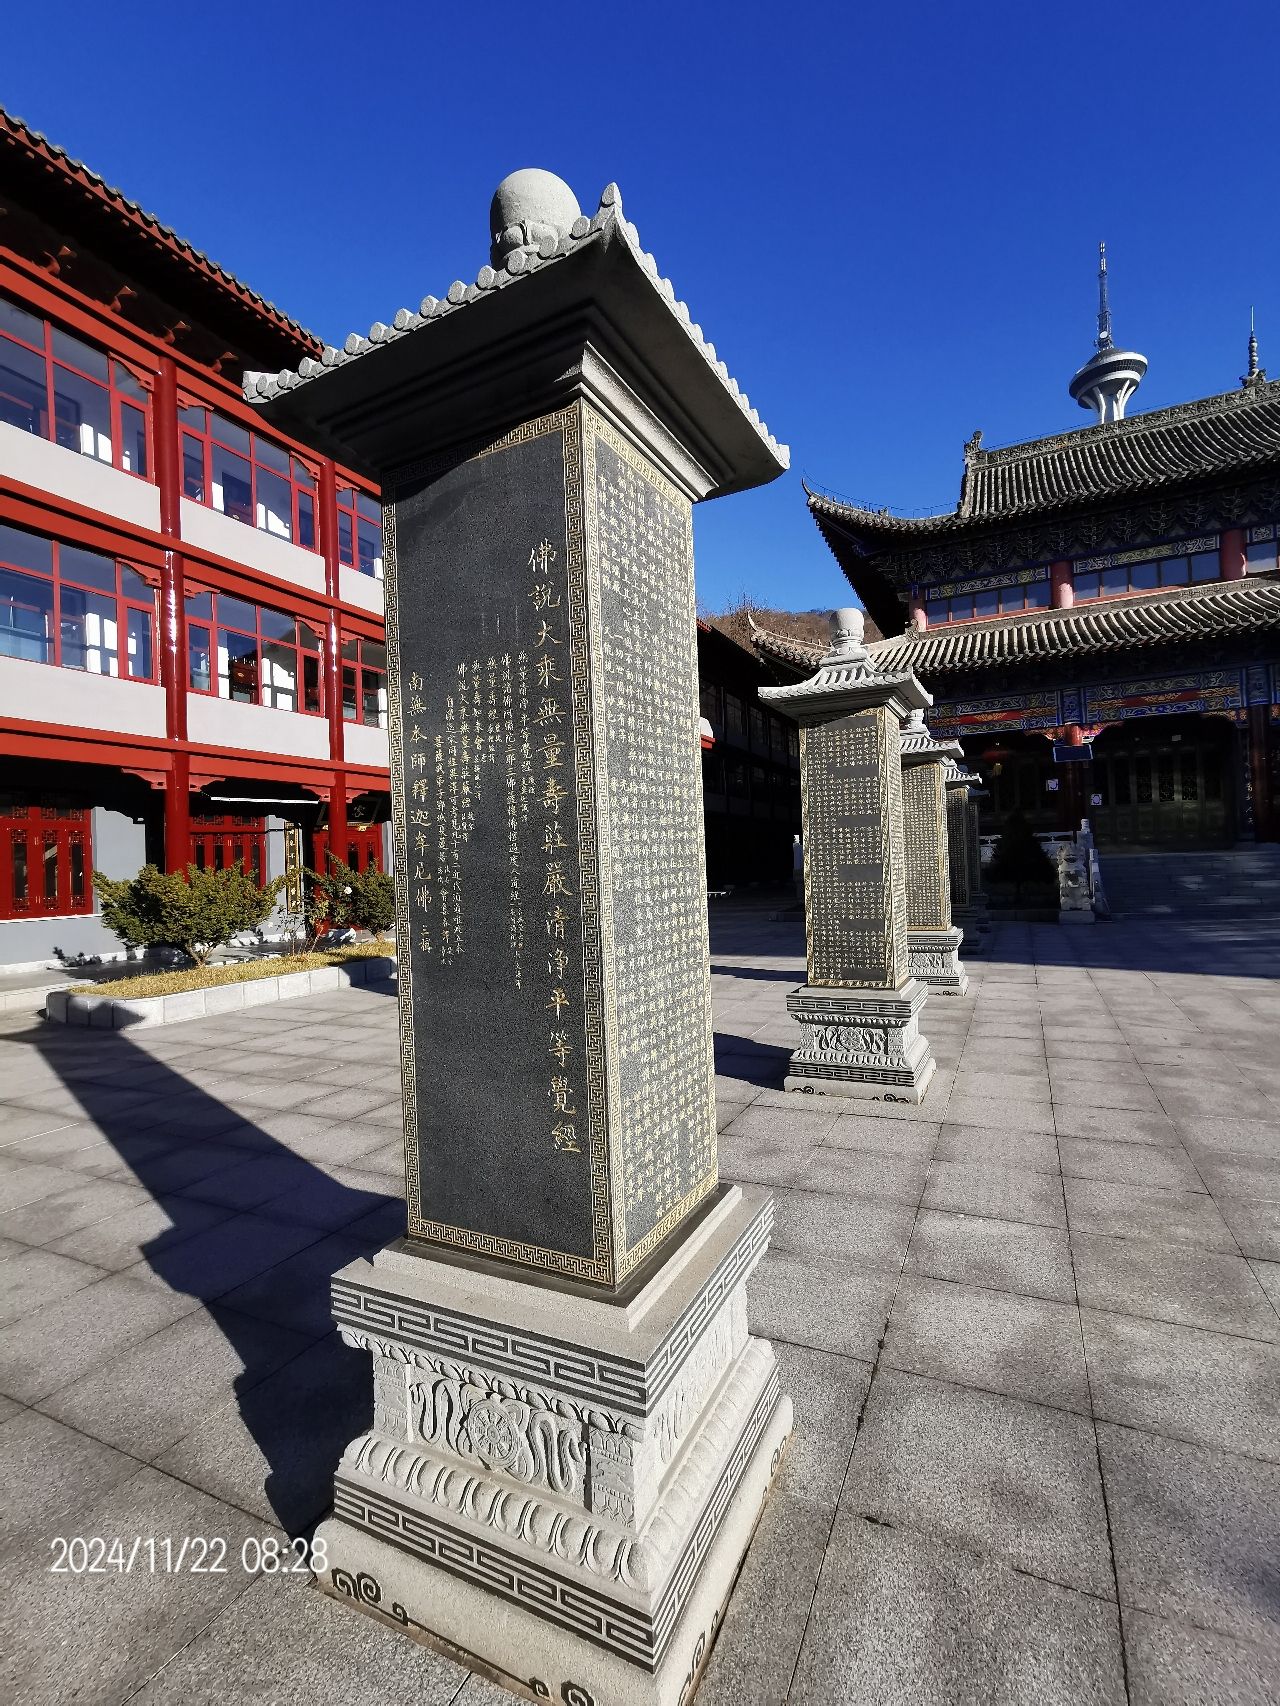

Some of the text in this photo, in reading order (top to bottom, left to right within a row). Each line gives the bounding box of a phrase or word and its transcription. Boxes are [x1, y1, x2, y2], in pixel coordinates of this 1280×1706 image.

[406, 672, 431, 912] 南無本師釋迦牟尼佛
